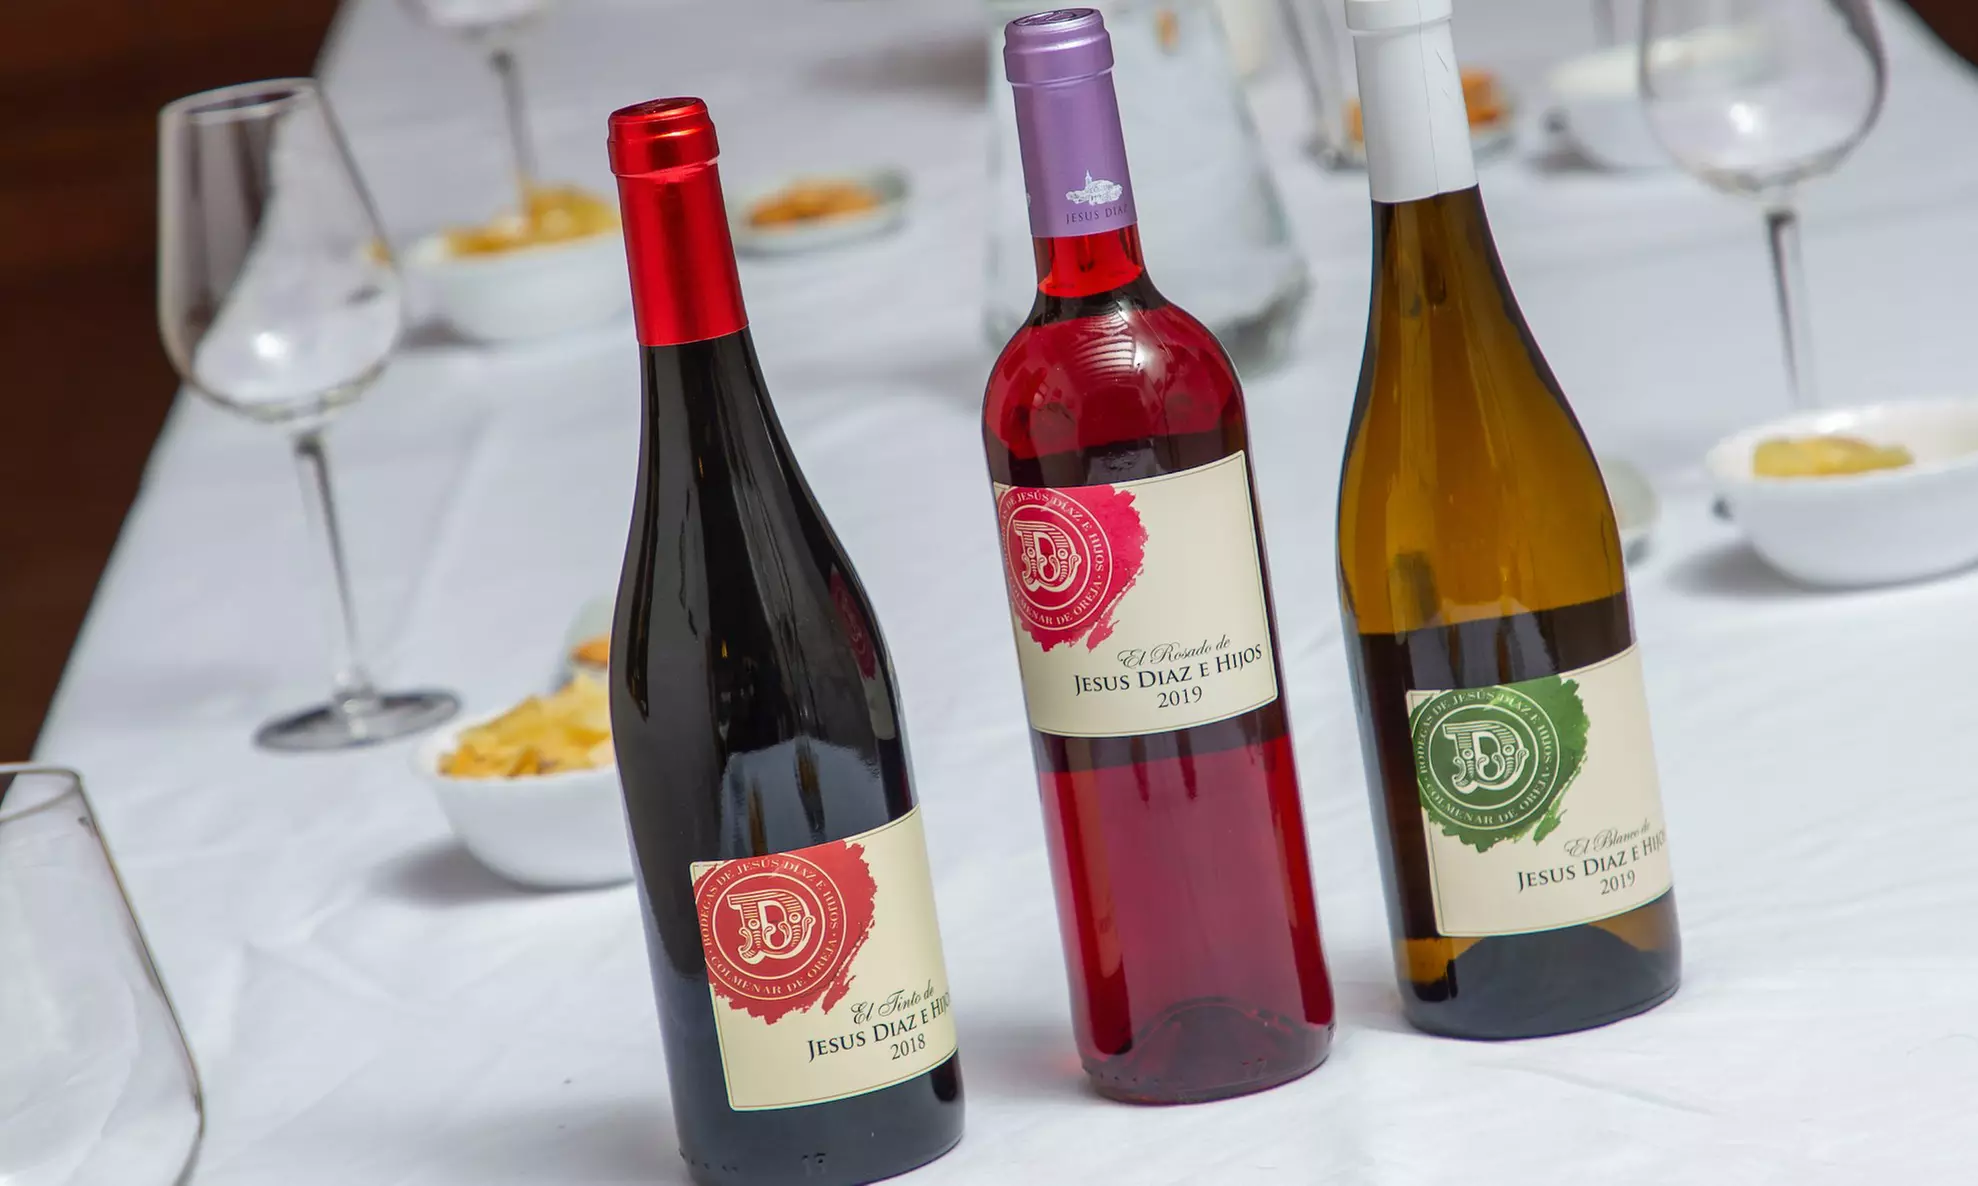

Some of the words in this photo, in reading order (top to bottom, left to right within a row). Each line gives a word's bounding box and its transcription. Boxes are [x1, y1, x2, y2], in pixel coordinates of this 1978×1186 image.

[1066, 210, 1100, 225] JESUS
[1016, 489, 1049, 505] JESÚS
[1088, 533, 1104, 572] HIJOS
[1056, 612, 1074, 625] DE
[1073, 580, 1102, 618] OREJA
[1117, 649, 1147, 669] El
[1149, 640, 1212, 666] Rosado
[1215, 634, 1231, 650] de
[1073, 674, 1130, 697] JESUS
[1138, 665, 1193, 689] DIAZ
[1199, 662, 1210, 678] E
[1157, 687, 1203, 709] 2019
[1417, 716, 1432, 773] BODEGAS
[1432, 701, 1450, 715] DE
[1452, 689, 1495, 705] JESÚS
[1530, 715, 1540, 725] E
[1538, 725, 1552, 764] HIJOS
[1425, 782, 1493, 824] COLMENAR
[1499, 811, 1518, 824] DE
[1564, 837, 1591, 857] El
[1593, 829, 1640, 853] Blanco
[1638, 818, 1650, 837] de
[1517, 864, 1576, 893] JESUS
[1583, 851, 1628, 877] DIAZ
[1632, 845, 1640, 862] E
[1600, 870, 1637, 895] 2019
[700, 885, 718, 947] BODEGAS
[717, 869, 733, 886] DE
[737, 857, 779, 876] JESÚS
[784, 859, 817, 882] DÍAZ
[817, 880, 827, 891] E
[823, 890, 839, 930] HIJOS
[711, 956, 782, 996] COLMENAR
[787, 979, 807, 995] DE
[810, 939, 838, 978] OREJA
[851, 1002, 873, 1025] El
[878, 989, 921, 1017] Tinto
[920, 979, 935, 1001] de
[806, 1031, 867, 1063] JESUS
[873, 1014, 918, 1042] DIAZ
[921, 1008, 929, 1025] E
[890, 1033, 927, 1060] 2018
